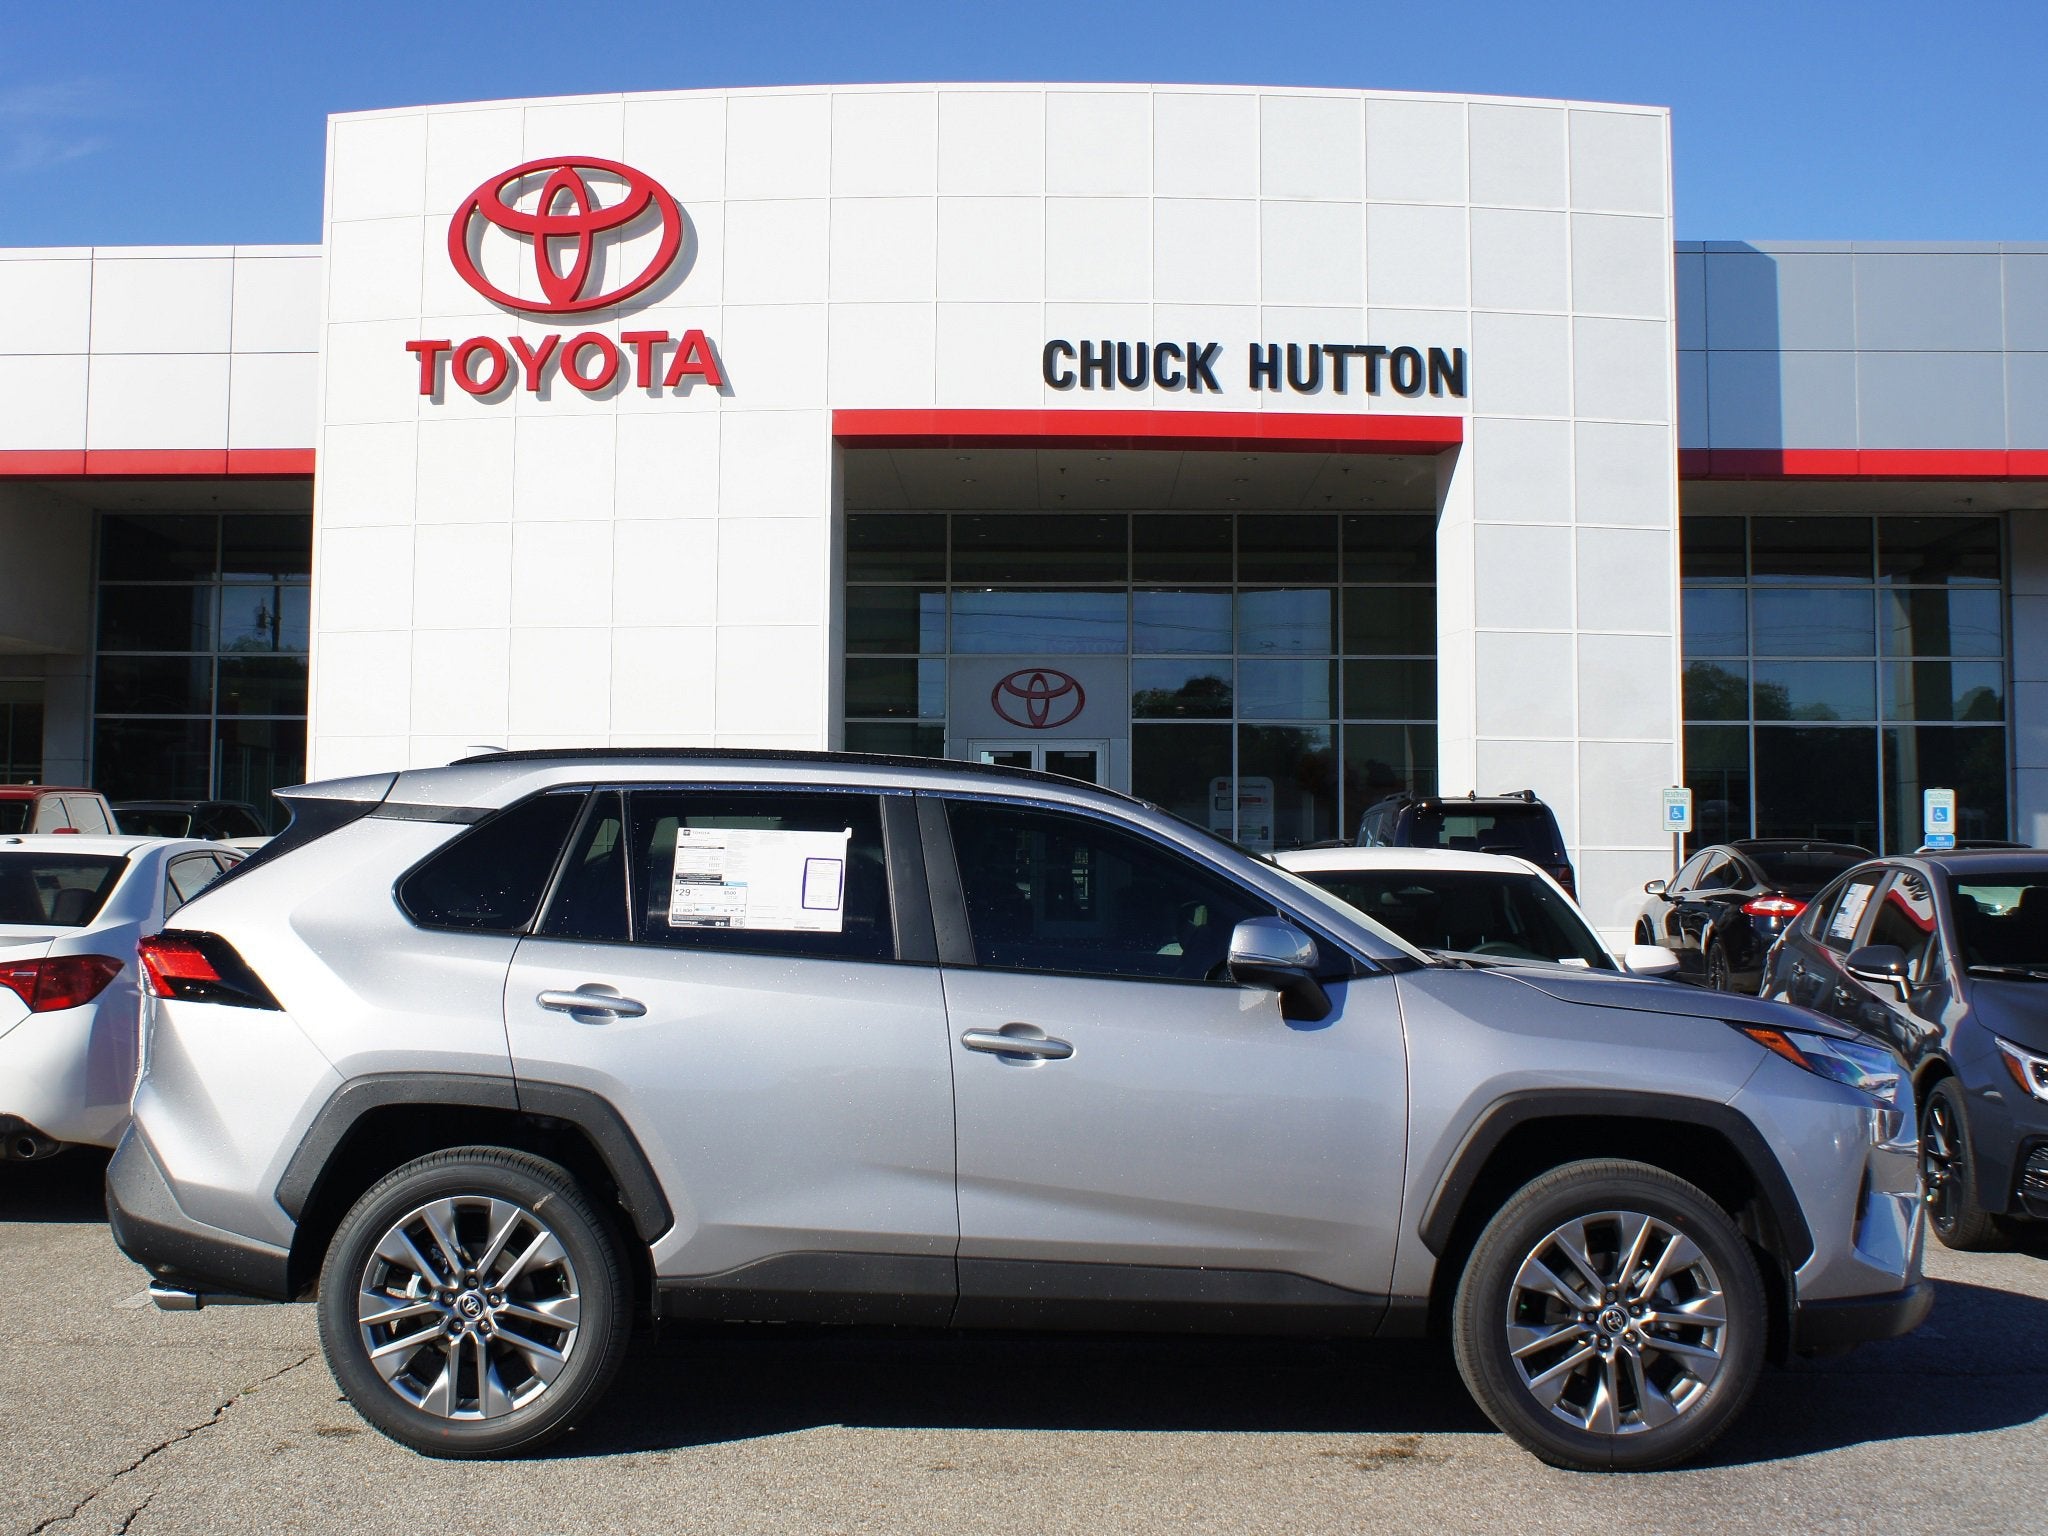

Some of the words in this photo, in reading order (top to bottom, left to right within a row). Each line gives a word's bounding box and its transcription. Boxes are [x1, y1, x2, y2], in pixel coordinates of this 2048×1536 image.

[405, 329, 723, 396] TOYOTA
[1042, 339, 1218, 390] CHUCK
[1249, 342, 1465, 397] HUTTON
[679, 888, 691, 897] 29
